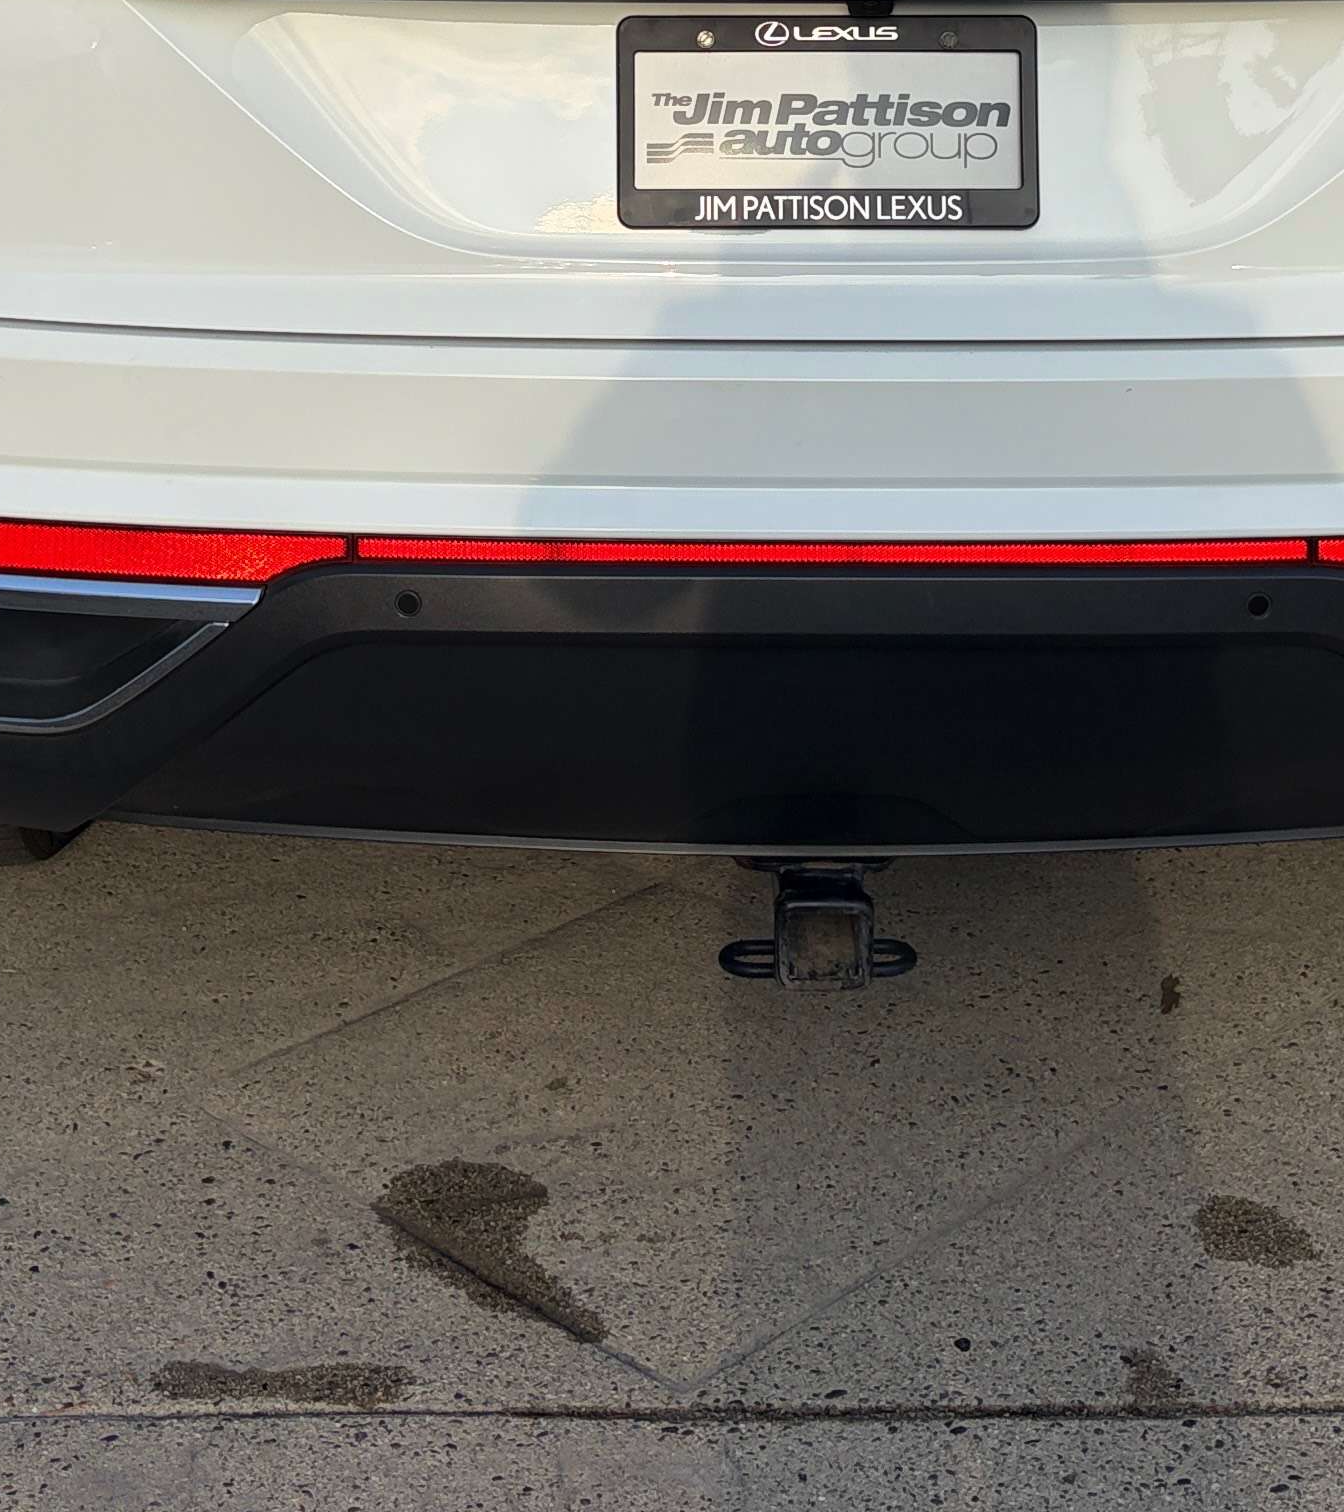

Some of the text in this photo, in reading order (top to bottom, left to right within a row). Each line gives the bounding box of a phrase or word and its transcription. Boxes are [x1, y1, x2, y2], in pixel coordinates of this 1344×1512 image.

[793, 25, 899, 42] LEXUS
[651, 92, 1011, 128] The Jim Pattison
[694, 194, 963, 222] JIM PATTISON LEXUS
